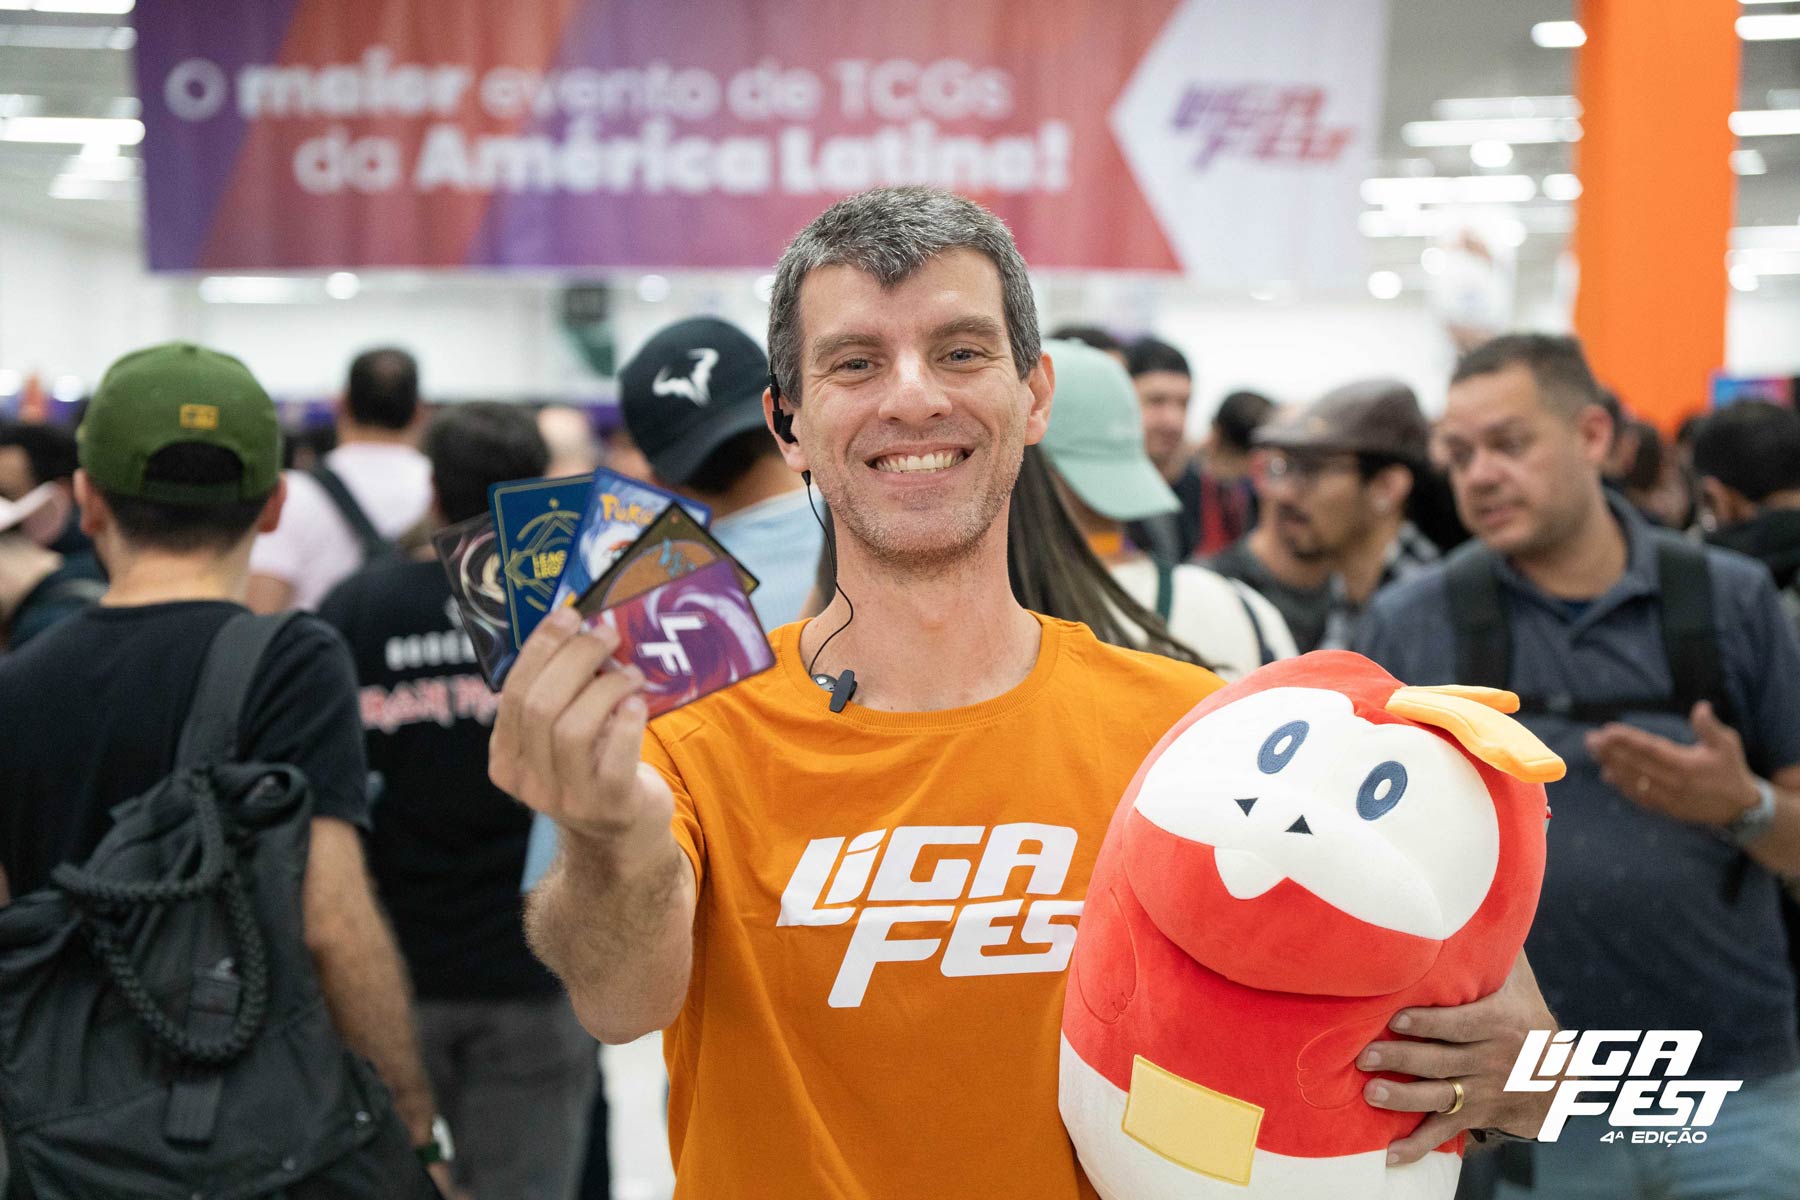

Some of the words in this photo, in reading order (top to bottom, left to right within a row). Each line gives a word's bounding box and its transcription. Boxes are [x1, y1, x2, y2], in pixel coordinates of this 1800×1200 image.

[165, 58, 227, 121] O
[238, 47, 471, 118] maior
[480, 58, 721, 121] evento
[726, 56, 821, 121] de
[832, 57, 1013, 121] TCGs
[293, 128, 399, 193] da
[415, 117, 774, 193] América
[781, 121, 1071, 193] Latina!
[827, 898, 1085, 1008] FES
